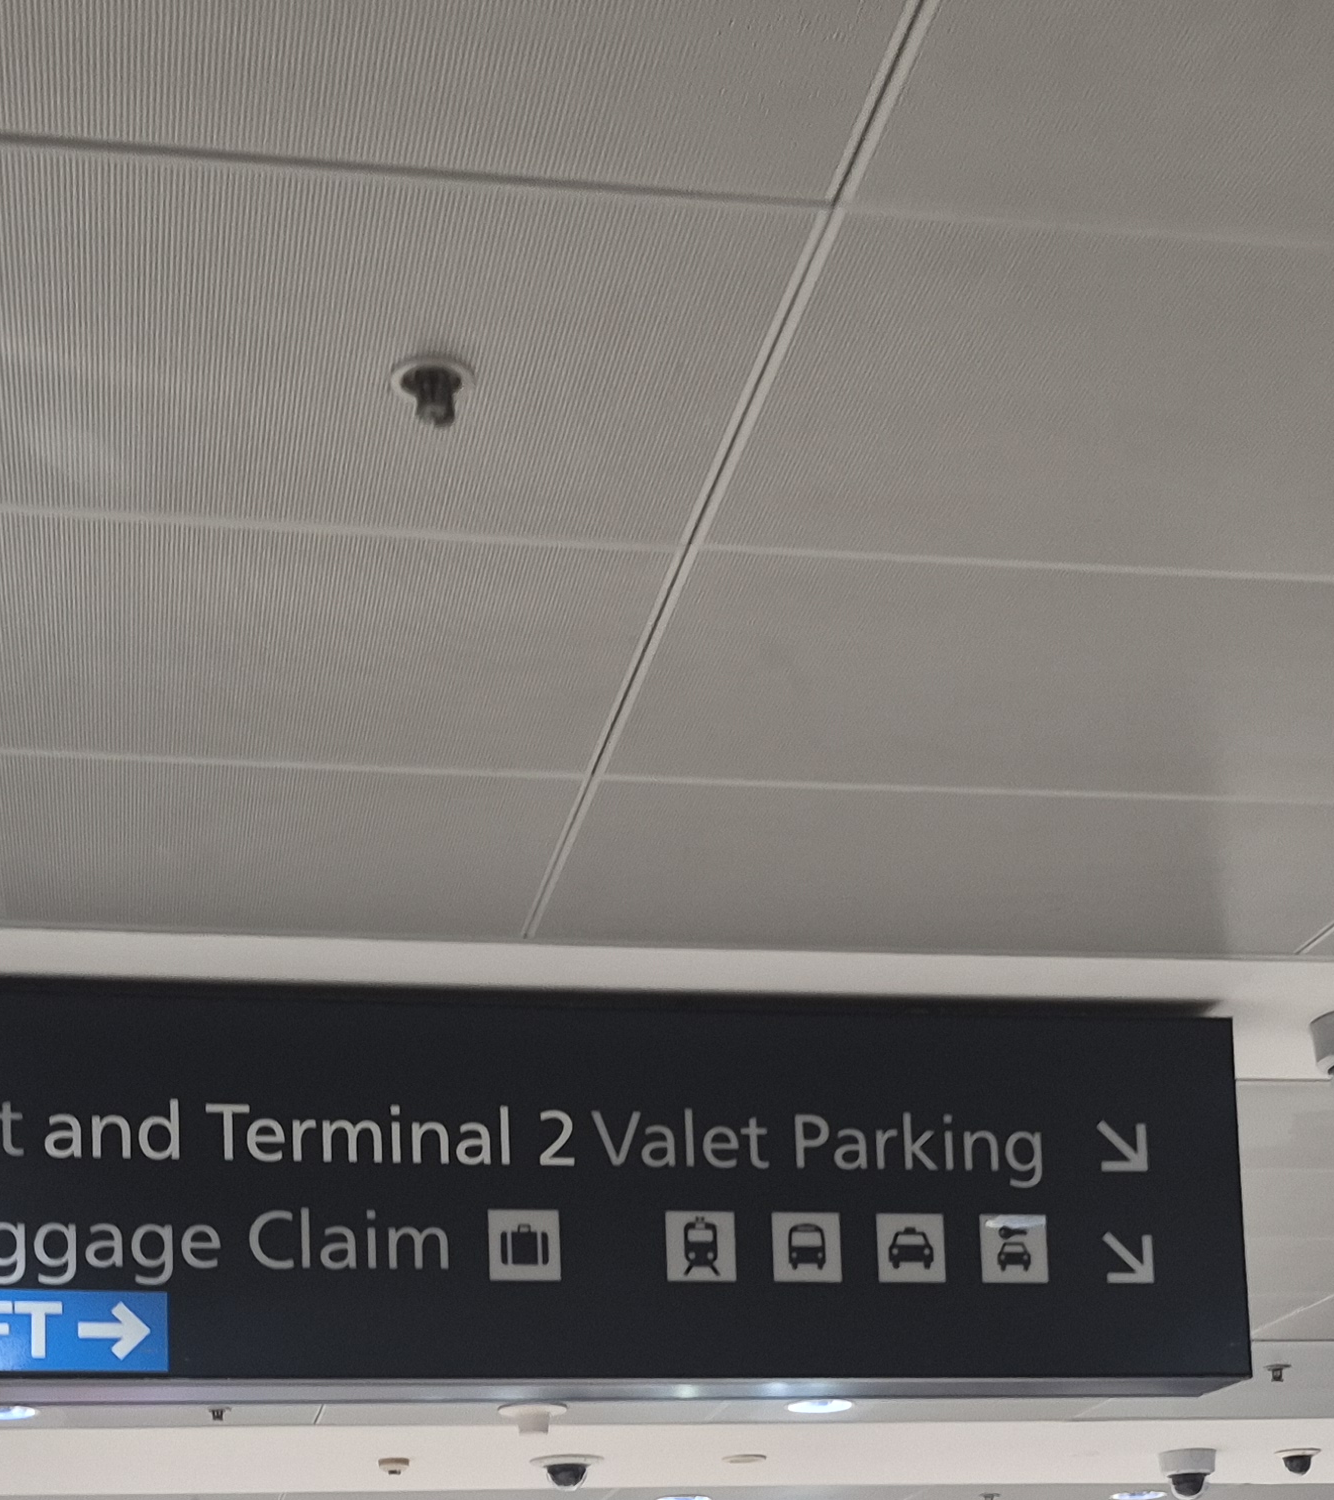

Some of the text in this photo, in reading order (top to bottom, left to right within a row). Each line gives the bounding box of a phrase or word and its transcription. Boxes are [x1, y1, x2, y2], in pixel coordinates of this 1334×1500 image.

[43, 1098, 180, 1160] and
[205, 1103, 512, 1165] Terminal
[538, 1109, 576, 1167] 2
[591, 1108, 1044, 1189] Valet Parking
[247, 1207, 451, 1271] Claim
